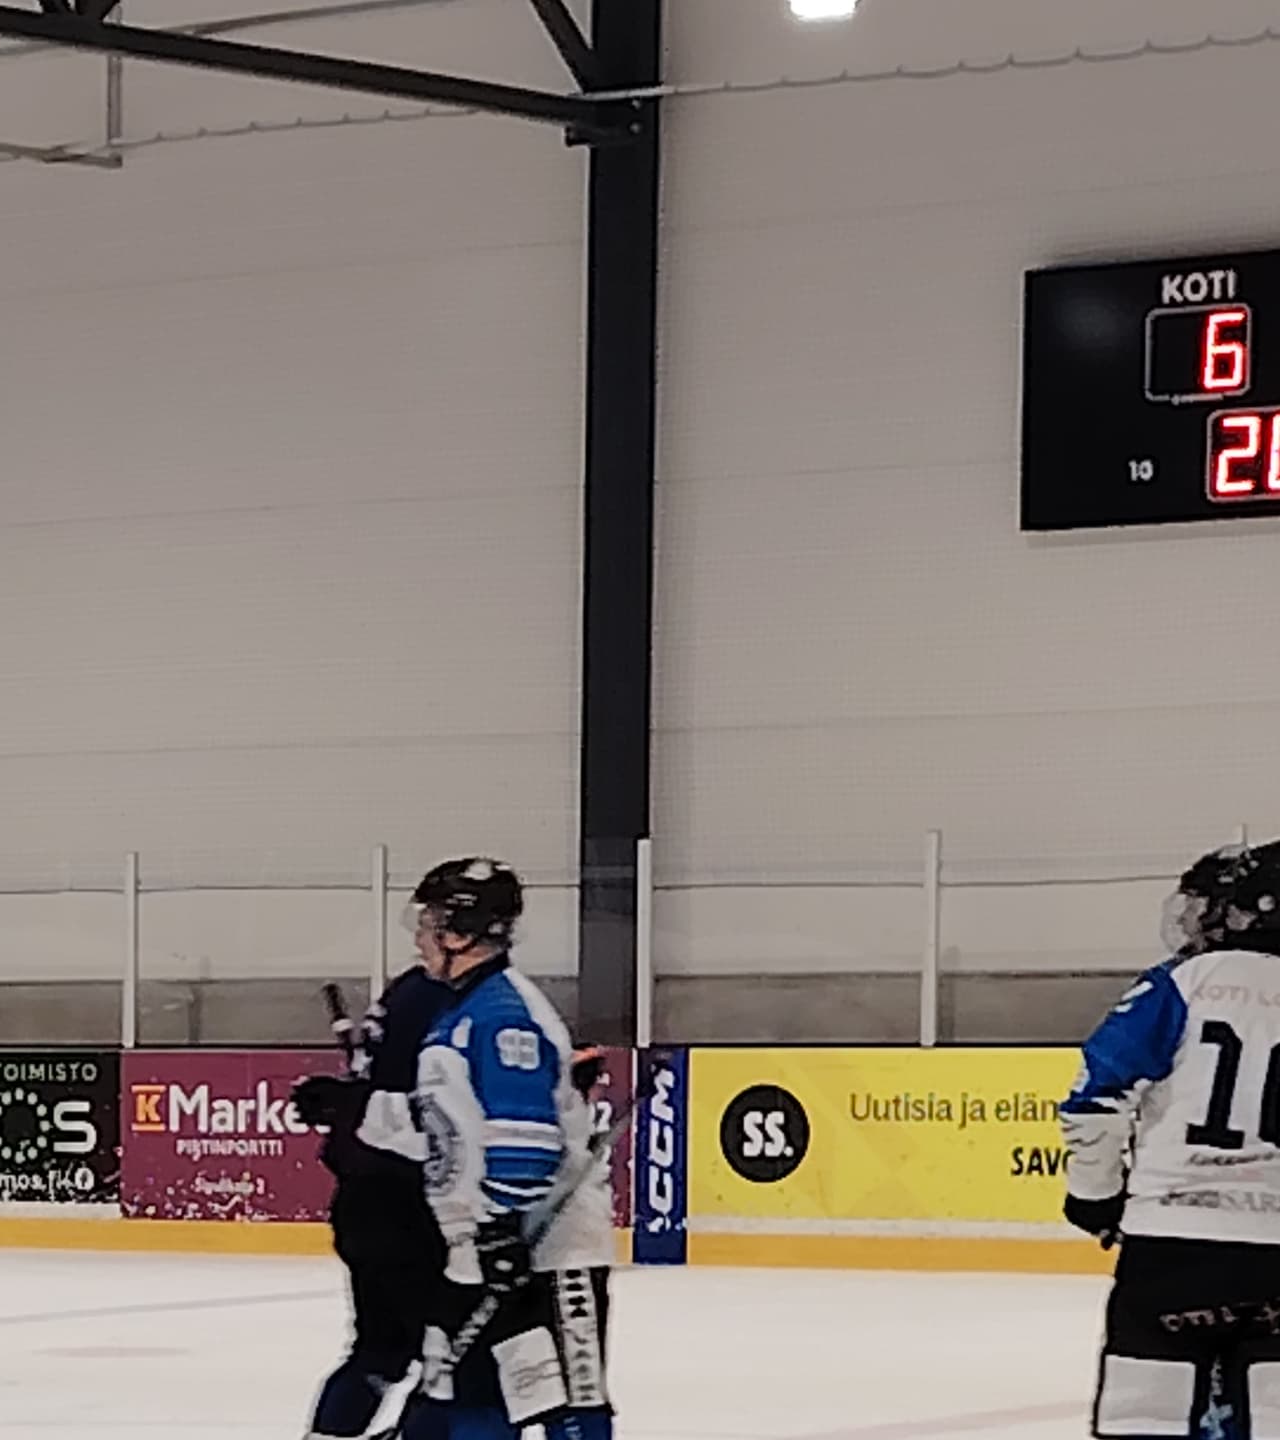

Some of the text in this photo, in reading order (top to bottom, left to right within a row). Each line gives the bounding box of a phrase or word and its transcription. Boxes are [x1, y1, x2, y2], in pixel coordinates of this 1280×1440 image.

[1161, 269, 1237, 304] KOTI
[1202, 311, 1247, 390] 6
[1128, 460, 1154, 481] 10
[134, 1079, 331, 1134] K Marke
[850, 1092, 953, 1122] Uutisia
[957, 1092, 987, 1131] ja
[649, 1066, 676, 1215] CCM
[743, 1110, 795, 1158] SS.
